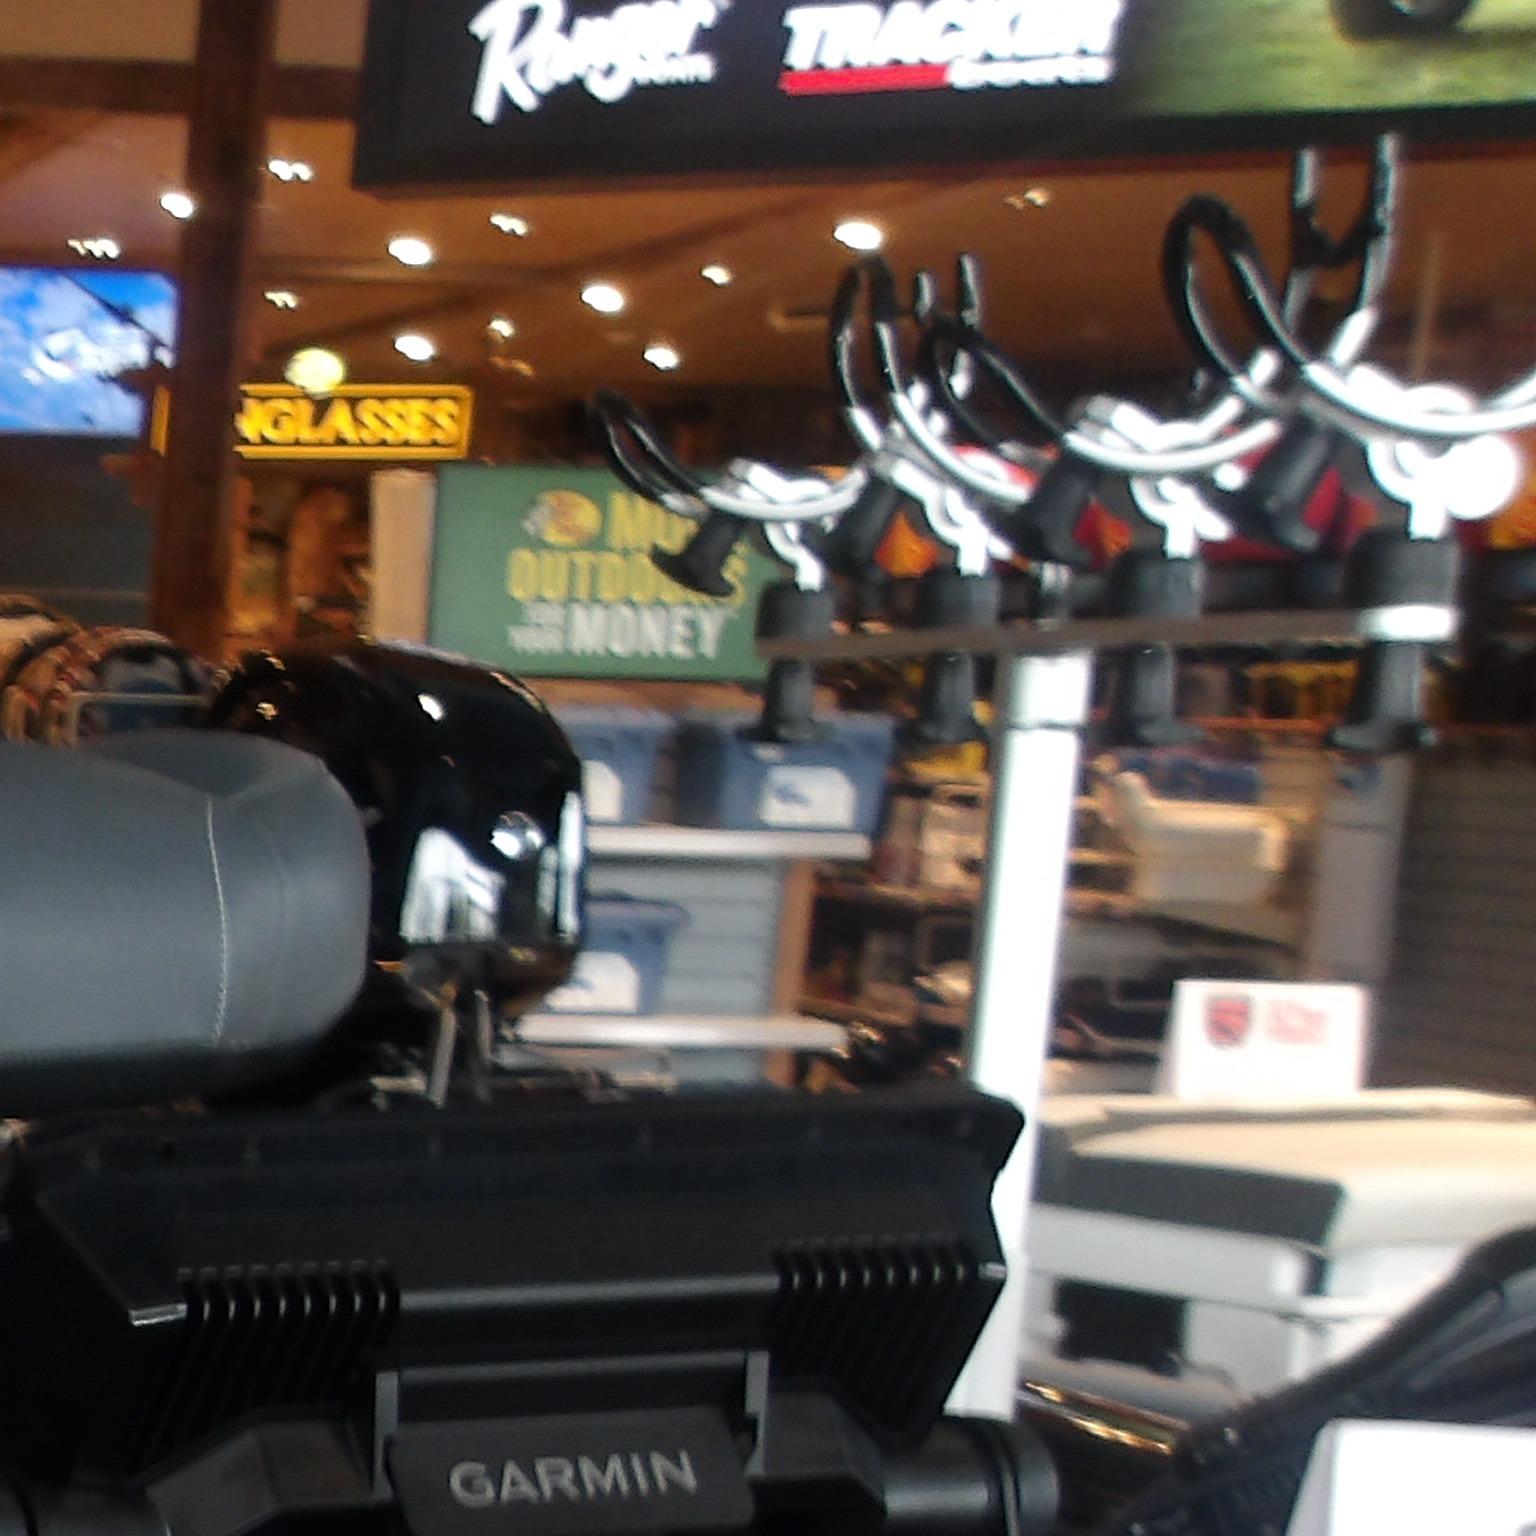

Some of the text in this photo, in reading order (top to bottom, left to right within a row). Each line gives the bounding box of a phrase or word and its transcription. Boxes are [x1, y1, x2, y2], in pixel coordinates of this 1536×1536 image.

[781, 0, 1123, 71] TRACKER
[569, 602, 730, 658] MONEY
[448, 1449, 699, 1509] GARMIN
